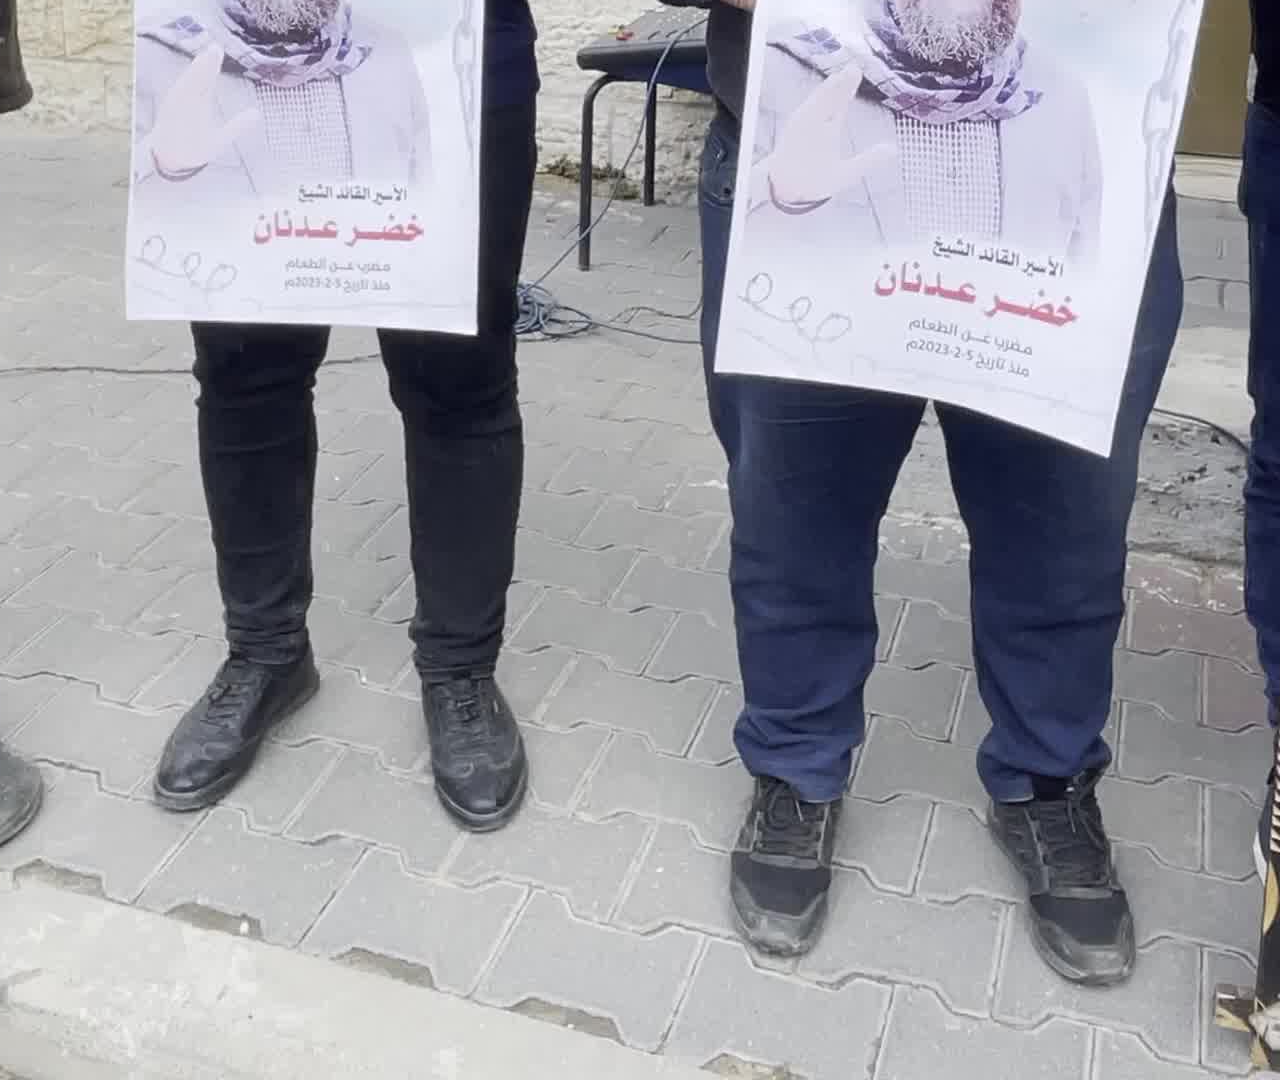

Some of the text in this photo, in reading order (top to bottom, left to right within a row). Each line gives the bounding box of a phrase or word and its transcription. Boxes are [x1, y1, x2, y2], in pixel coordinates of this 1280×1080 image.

[254, 209, 424, 247] خضر عدنان
[932, 235, 975, 258] الشيخ
[979, 248, 1020, 268] القائد
[874, 261, 1079, 327] خضر عدنان
